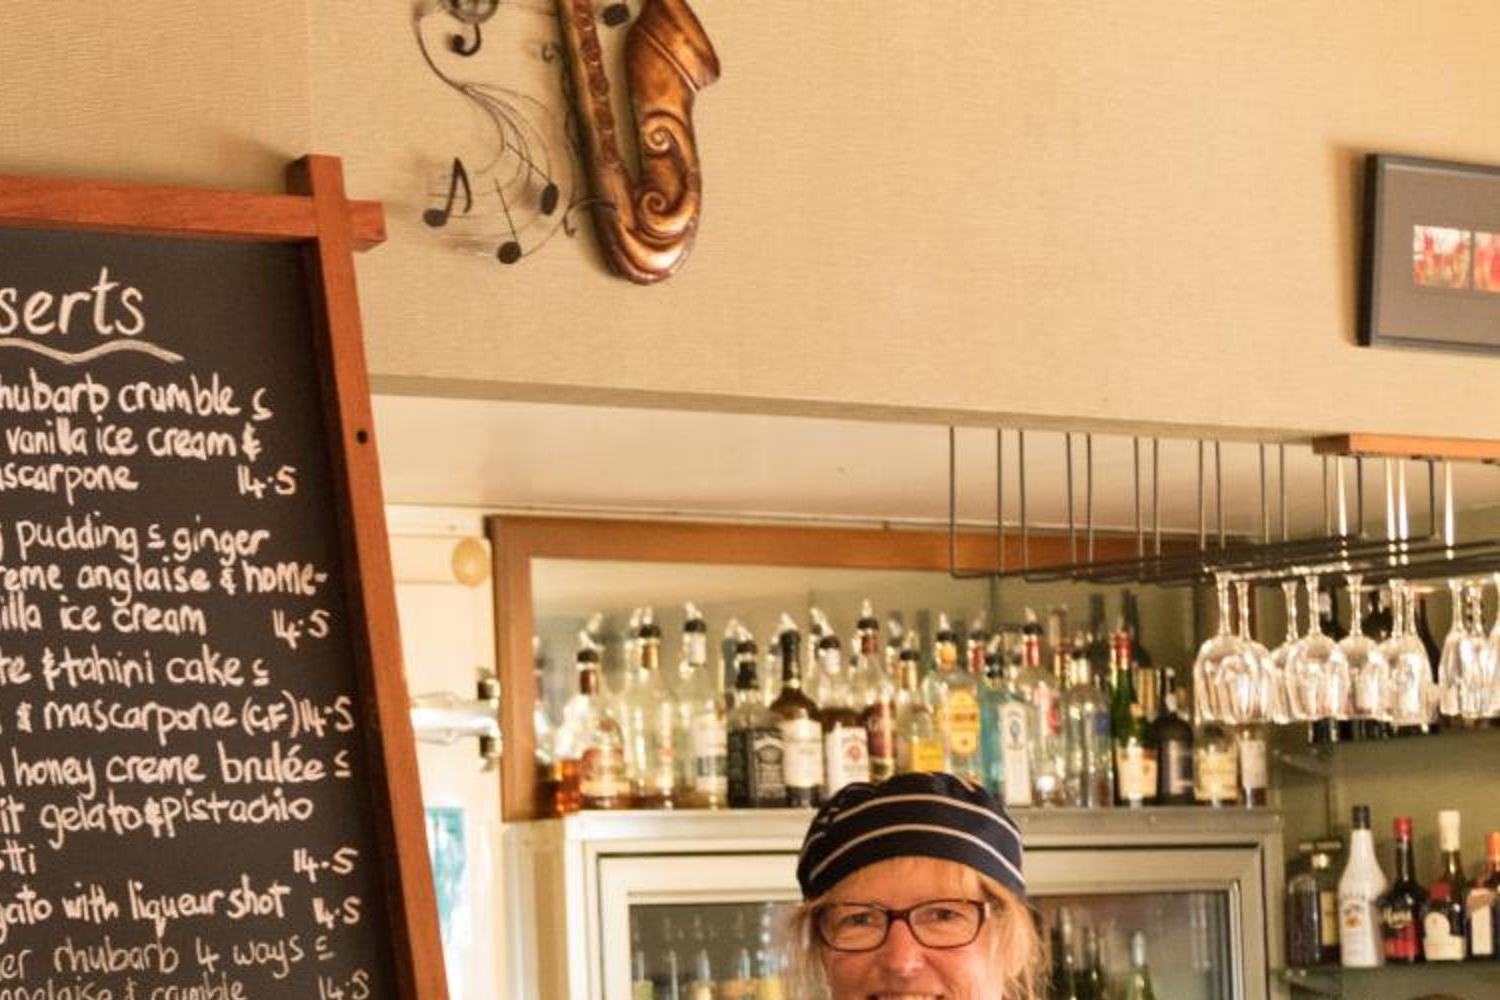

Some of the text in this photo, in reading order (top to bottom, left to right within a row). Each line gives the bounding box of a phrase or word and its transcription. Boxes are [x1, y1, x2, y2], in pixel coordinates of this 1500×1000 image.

[117, 372, 242, 417] crumble
[6, 416, 88, 457] vanilla
[96, 414, 139, 457] ice
[147, 425, 237, 460] cream
[241, 421, 263, 463] &
[15, 509, 139, 565] pudding
[171, 514, 272, 568] ginger
[76, 554, 212, 607] anglaise
[219, 566, 238, 596] &
[240, 559, 329, 596] home-
[58, 594, 101, 634] ice
[111, 603, 208, 636] cream
[41, 646, 59, 692] &
[59, 643, 155, 689] tahini
[165, 643, 245, 688] cake
[43, 698, 238, 747] mascarpone
[241, 689, 300, 739] (GF)
[11, 745, 97, 801] honey
[105, 751, 207, 786] creme
[216, 739, 327, 784] brulée
[39, 787, 143, 851] gelato
[163, 787, 315, 839] pistachio
[60, 880, 121, 925] with
[226, 872, 293, 920] shot
[53, 935, 180, 976] rhubarb
[194, 936, 221, 975] 4
[232, 934, 305, 980] ways
